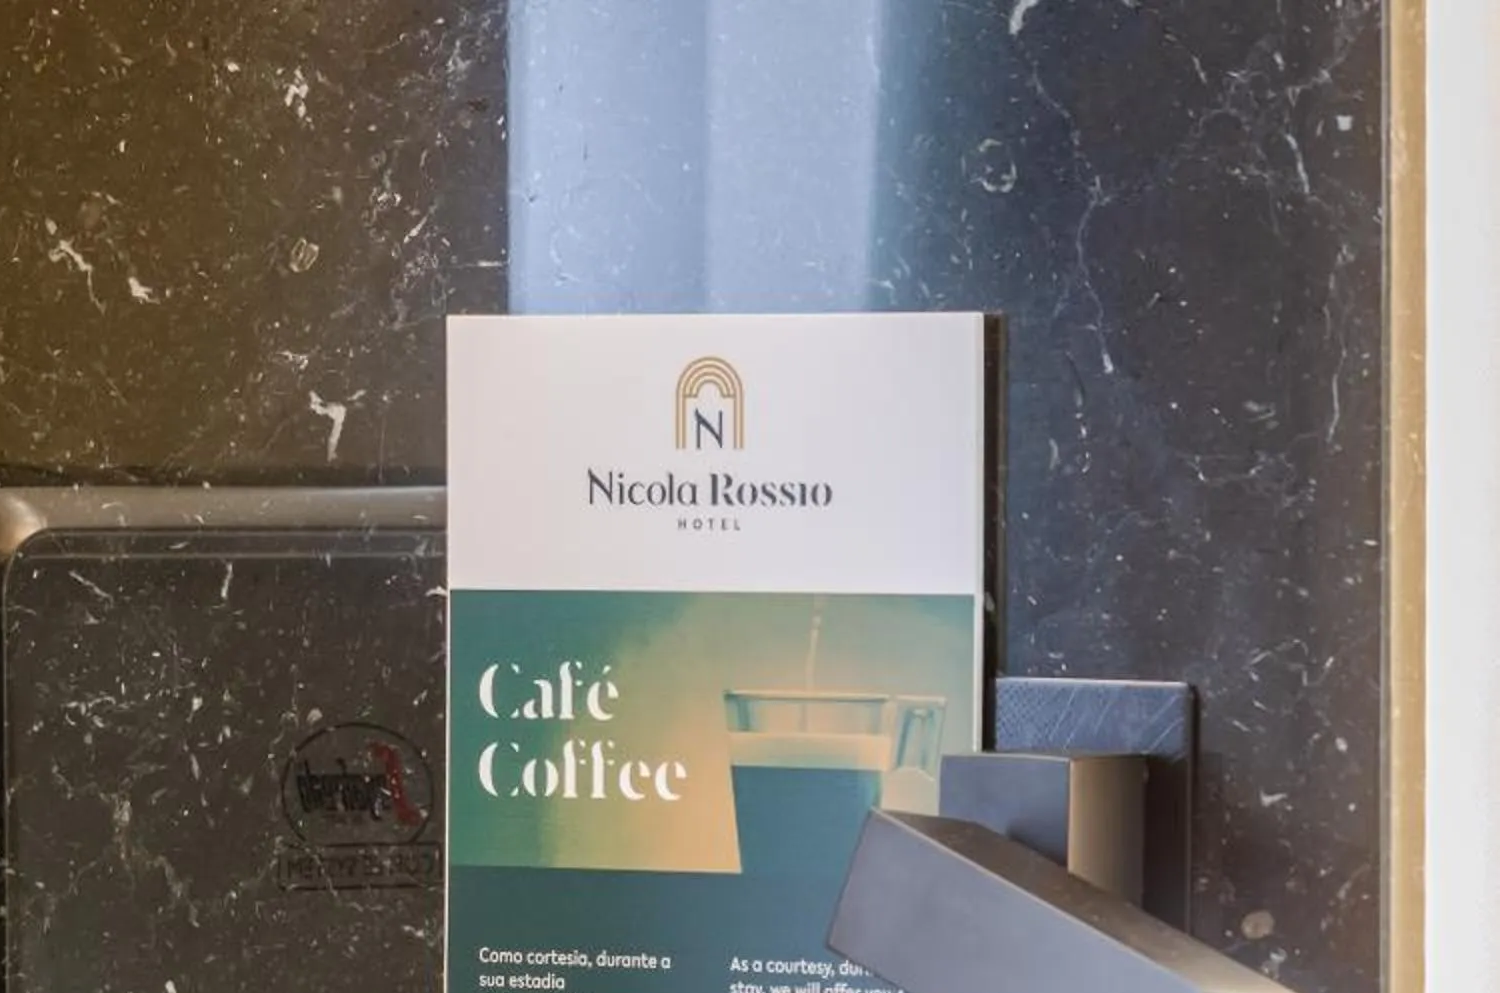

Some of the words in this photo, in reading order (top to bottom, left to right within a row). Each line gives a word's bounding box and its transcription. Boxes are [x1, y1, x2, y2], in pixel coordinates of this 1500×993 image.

[694, 408, 723, 450] N
[587, 468, 698, 505] Nicola
[709, 473, 833, 507] Rossio
[677, 518, 741, 531] HOTEL
[479, 661, 619, 721] Café
[478, 739, 687, 801] Coffee
[478, 947, 523, 964] Como
[526, 949, 593, 969] cortesia,
[596, 950, 657, 969] durante
[660, 956, 672, 969] a
[729, 956, 749, 972] As
[752, 959, 763, 972] a
[765, 959, 835, 979] courtesy,
[478, 974, 505, 988] sua
[508, 972, 566, 990] estadia
